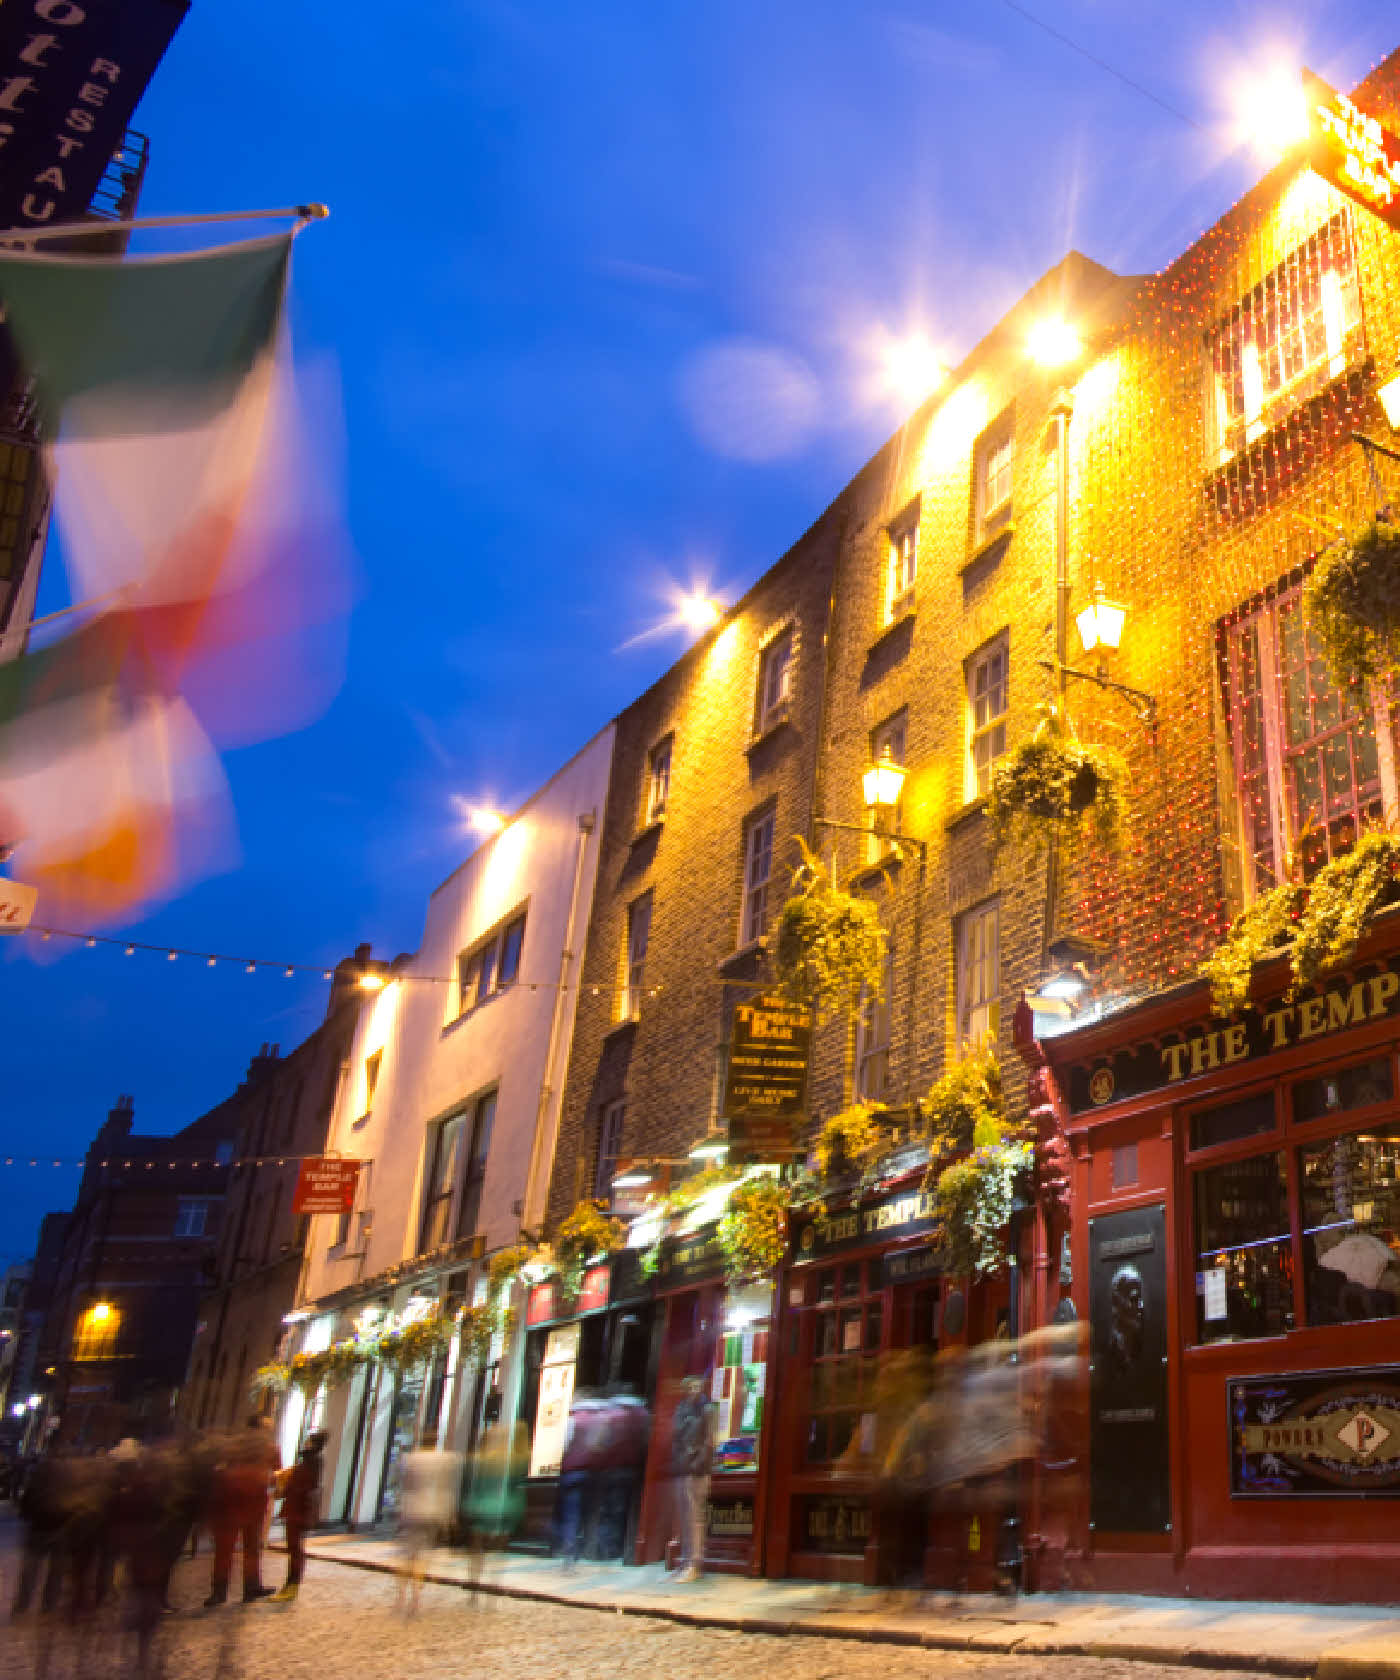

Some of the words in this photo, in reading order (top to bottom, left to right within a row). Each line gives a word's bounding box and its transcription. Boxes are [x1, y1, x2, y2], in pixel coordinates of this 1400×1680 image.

[1161, 1024, 1249, 1081] THE
[1263, 1429, 1324, 1448] POWERS
[1356, 1417, 1375, 1451] P
